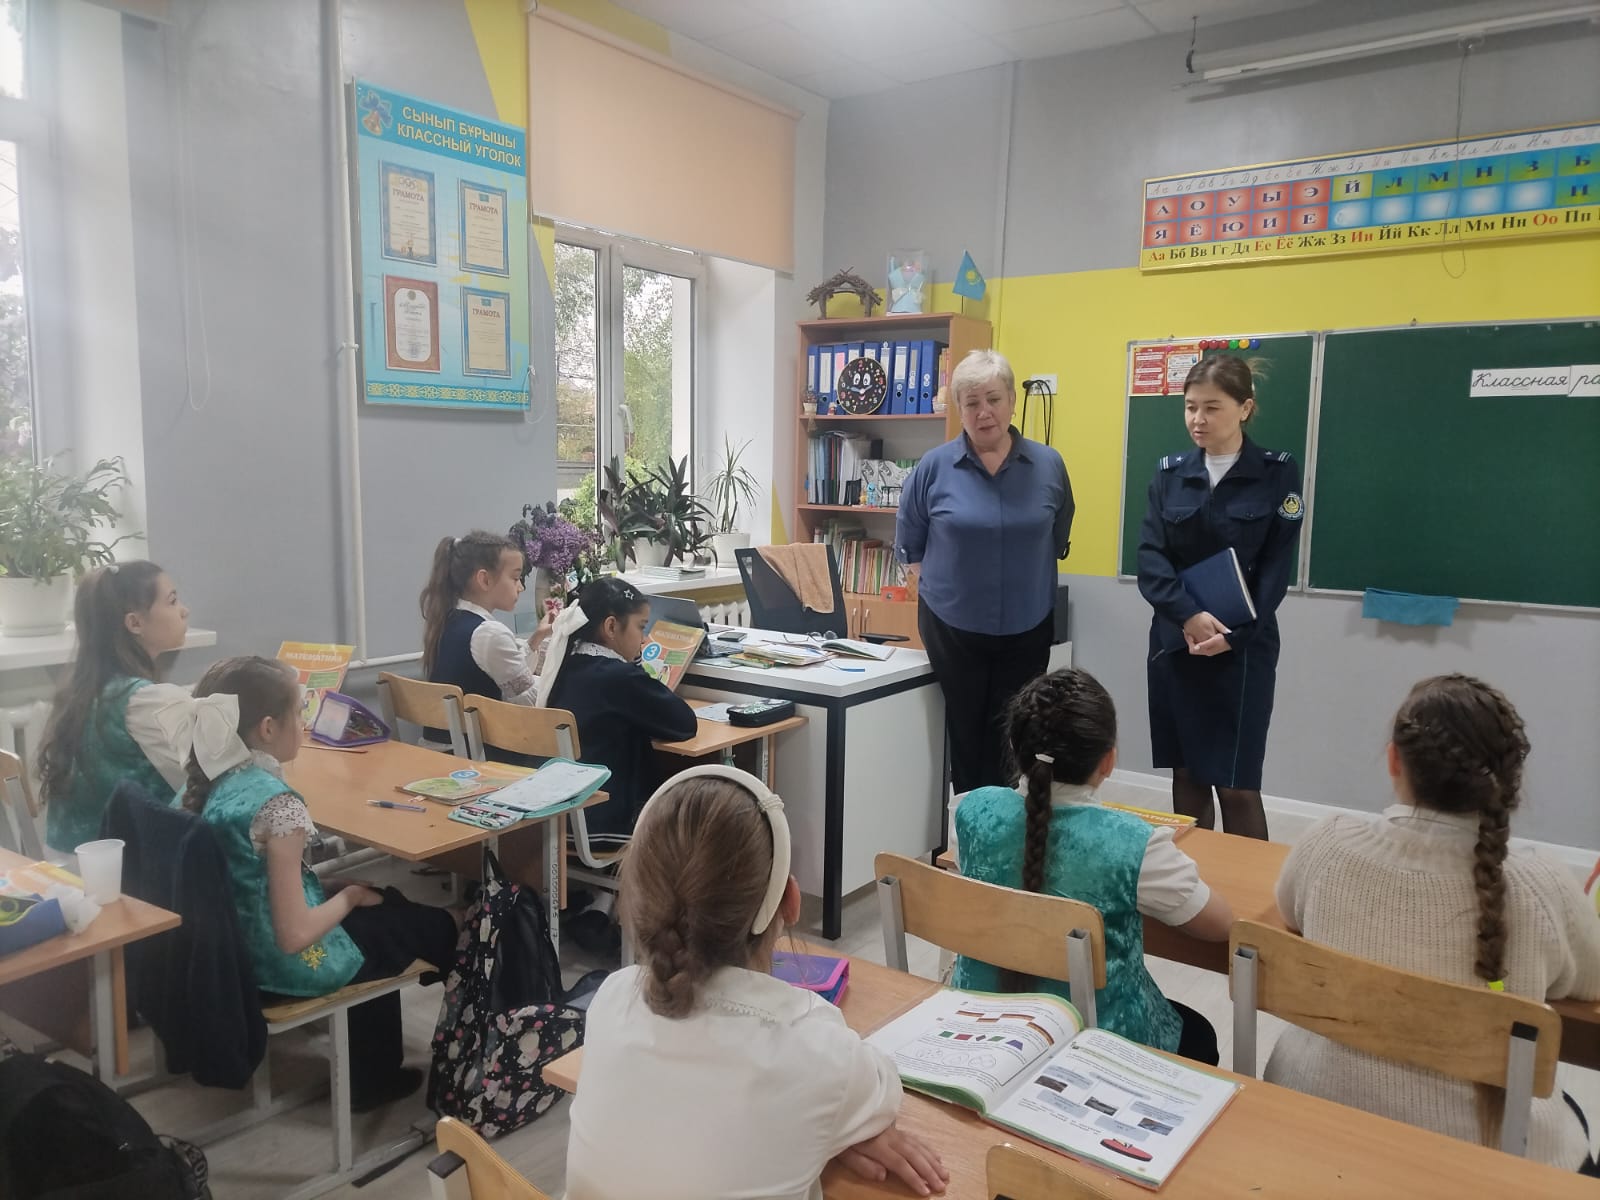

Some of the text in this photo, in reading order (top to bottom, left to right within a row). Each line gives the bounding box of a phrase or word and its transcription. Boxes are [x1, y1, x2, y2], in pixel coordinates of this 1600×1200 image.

[402, 106, 516, 149] СЫНЫП БҰРЫШЫ
[397, 123, 521, 167] КЛАССНЫЙ УГОЛОК
[392, 187, 425, 202] ГРАМОТА
[1157, 205, 1169, 215] А
[1190, 200, 1205, 210] О
[1228, 196, 1241, 207] У
[1263, 190, 1282, 202] Ы
[1304, 187, 1319, 197] Э
[1345, 180, 1360, 194] Й
[1385, 176, 1403, 188] Л
[1429, 171, 1449, 184] М
[1476, 165, 1493, 179] Н
[468, 202, 499, 216] ГРАМОТА
[1150, 251, 1165, 262] Аа
[1170, 247, 1187, 260] Бб
[1190, 246, 1208, 258] Вв
[1212, 244, 1229, 256] Гг
[1254, 240, 1272, 252] Ее
[1276, 236, 1294, 250] Ёё
[1298, 235, 1327, 248] Жж
[1330, 232, 1346, 245] Зз
[1351, 230, 1374, 243] Ии
[1379, 224, 1402, 241] Йй
[1407, 225, 1432, 238] Кк
[1434, 221, 1459, 235] Лл
[1465, 218, 1495, 233] Мм
[1502, 216, 1527, 229] Нн
[1533, 212, 1559, 226] Оо
[1565, 209, 1592, 224] Пп
[1155, 229, 1168, 240] Я
[1190, 223, 1202, 236] Ё
[1222, 221, 1244, 232] Ю
[1263, 217, 1277, 228] И
[1303, 213, 1316, 225] Е
[472, 307, 501, 319] ГРАМОТА
[1472, 371, 1568, 389] Классная
[646, 645, 658, 658] 3
